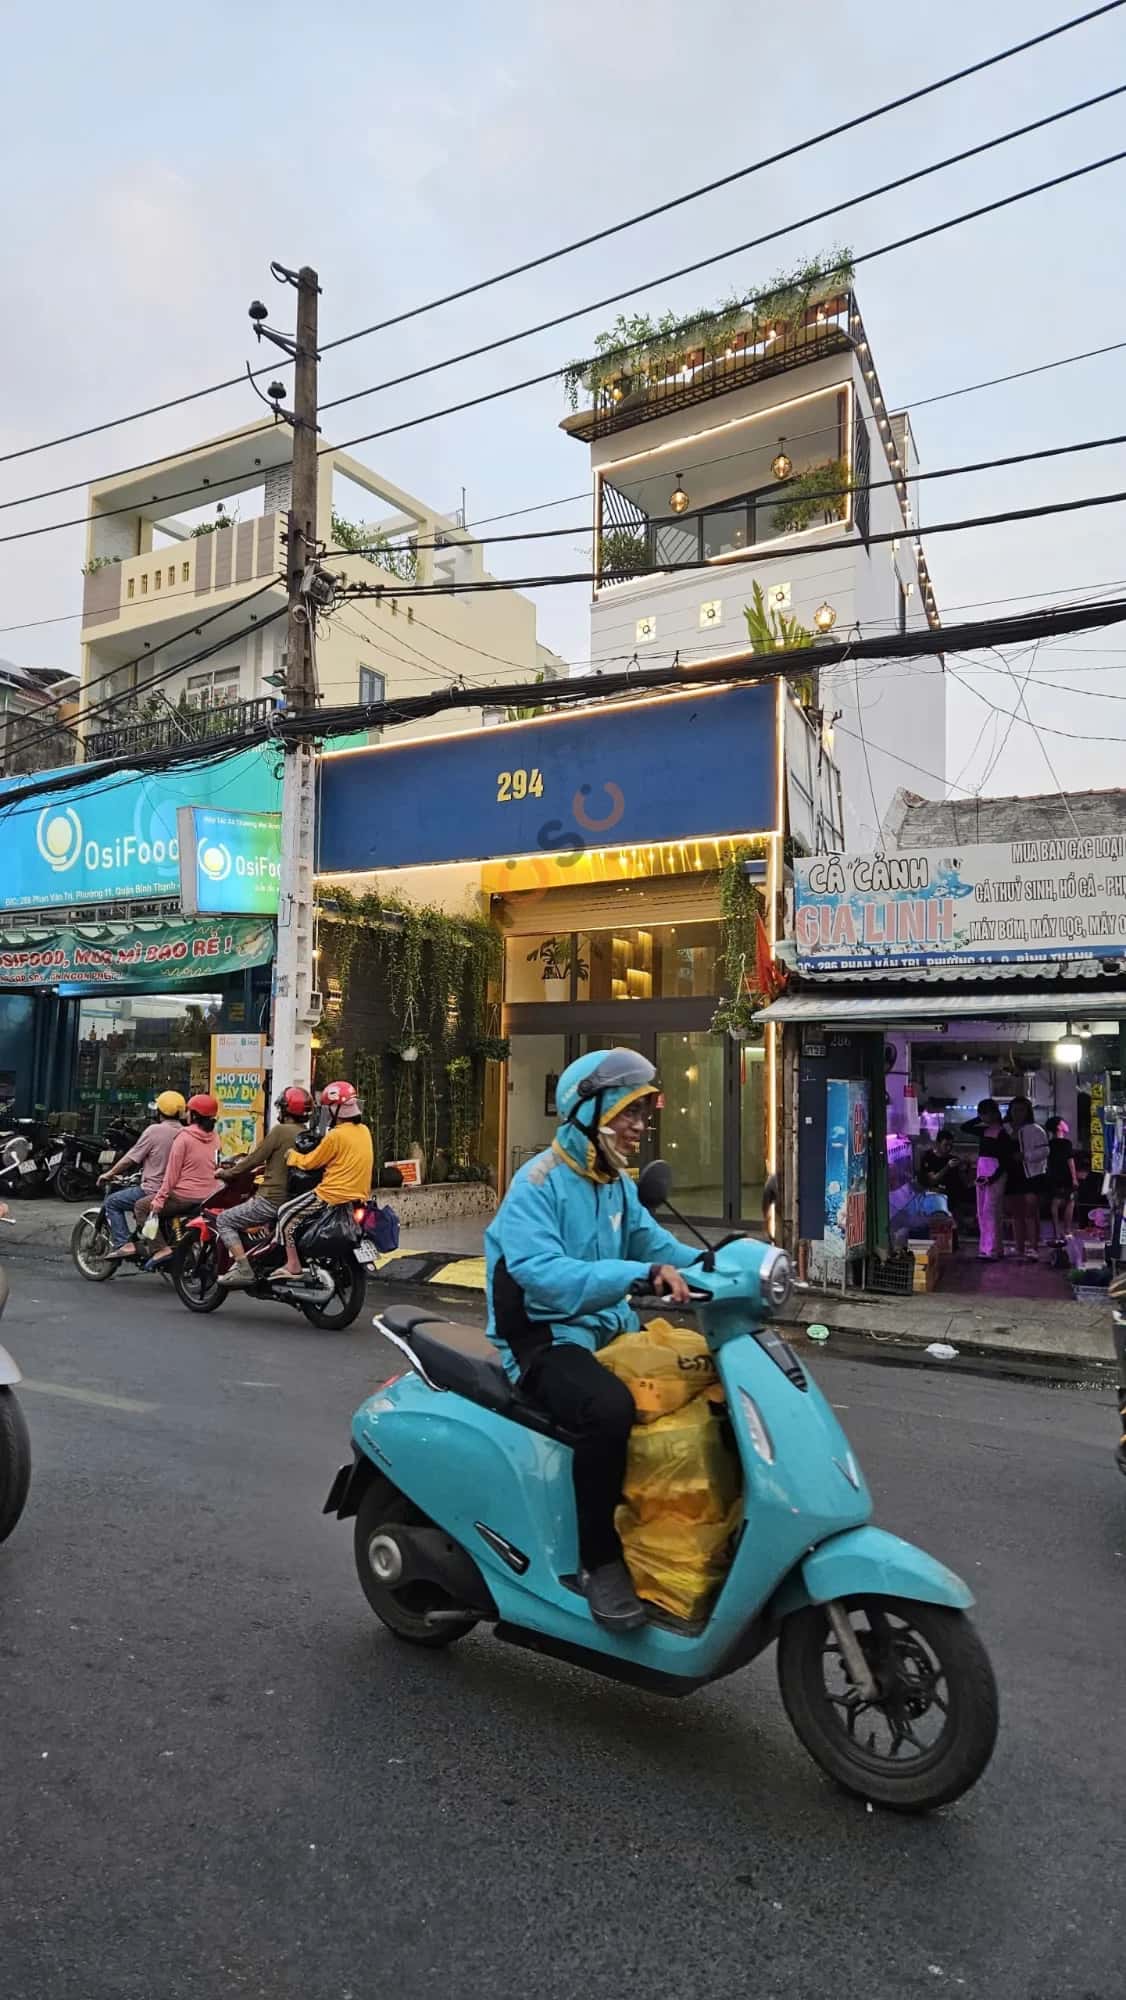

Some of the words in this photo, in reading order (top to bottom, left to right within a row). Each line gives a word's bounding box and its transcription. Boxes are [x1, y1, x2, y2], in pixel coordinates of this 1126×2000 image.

[496, 768, 545, 803] 294
[1011, 842, 1039, 864] MUA
[1095, 836, 1124, 861] LOẠI
[808, 855, 846, 894] CÁ
[852, 851, 929, 892] CẢNH
[975, 879, 993, 903] CÁ
[1024, 879, 1057, 901] SINH,
[1078, 873, 1097, 898] CÁ
[796, 903, 858, 947] GIA
[863, 898, 954, 945] LINH
[969, 916, 996, 941] MÁY
[999, 917, 1029, 942] BƠM,
[1030, 914, 1057, 939] MÁY
[1059, 915, 1088, 941] LỌC,
[1088, 911, 1117, 936] MÁY
[144, 940, 188, 963] BAO
[192, 931, 220, 958] RẺ
